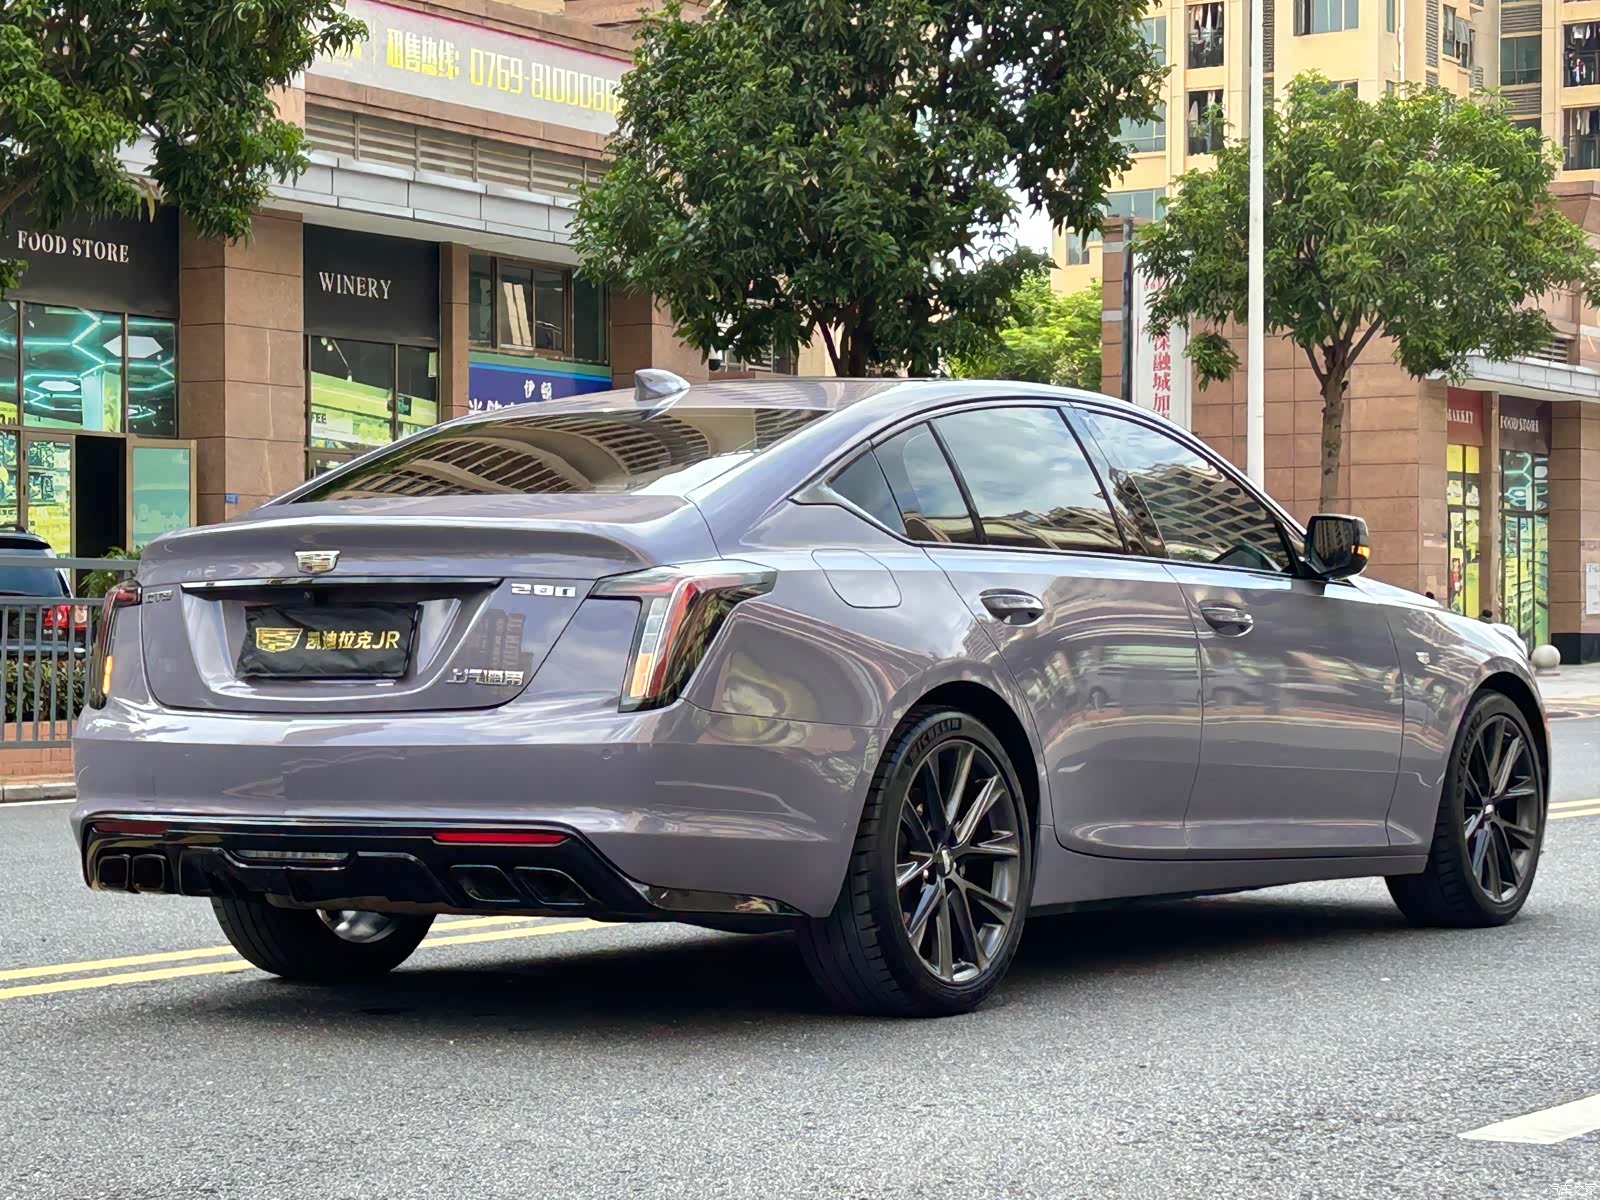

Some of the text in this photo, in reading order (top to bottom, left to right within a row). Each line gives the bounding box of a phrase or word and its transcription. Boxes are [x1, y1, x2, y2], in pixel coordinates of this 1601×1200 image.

[17, 230, 129, 263] FOOD STORE
[318, 271, 392, 299] WINERY
